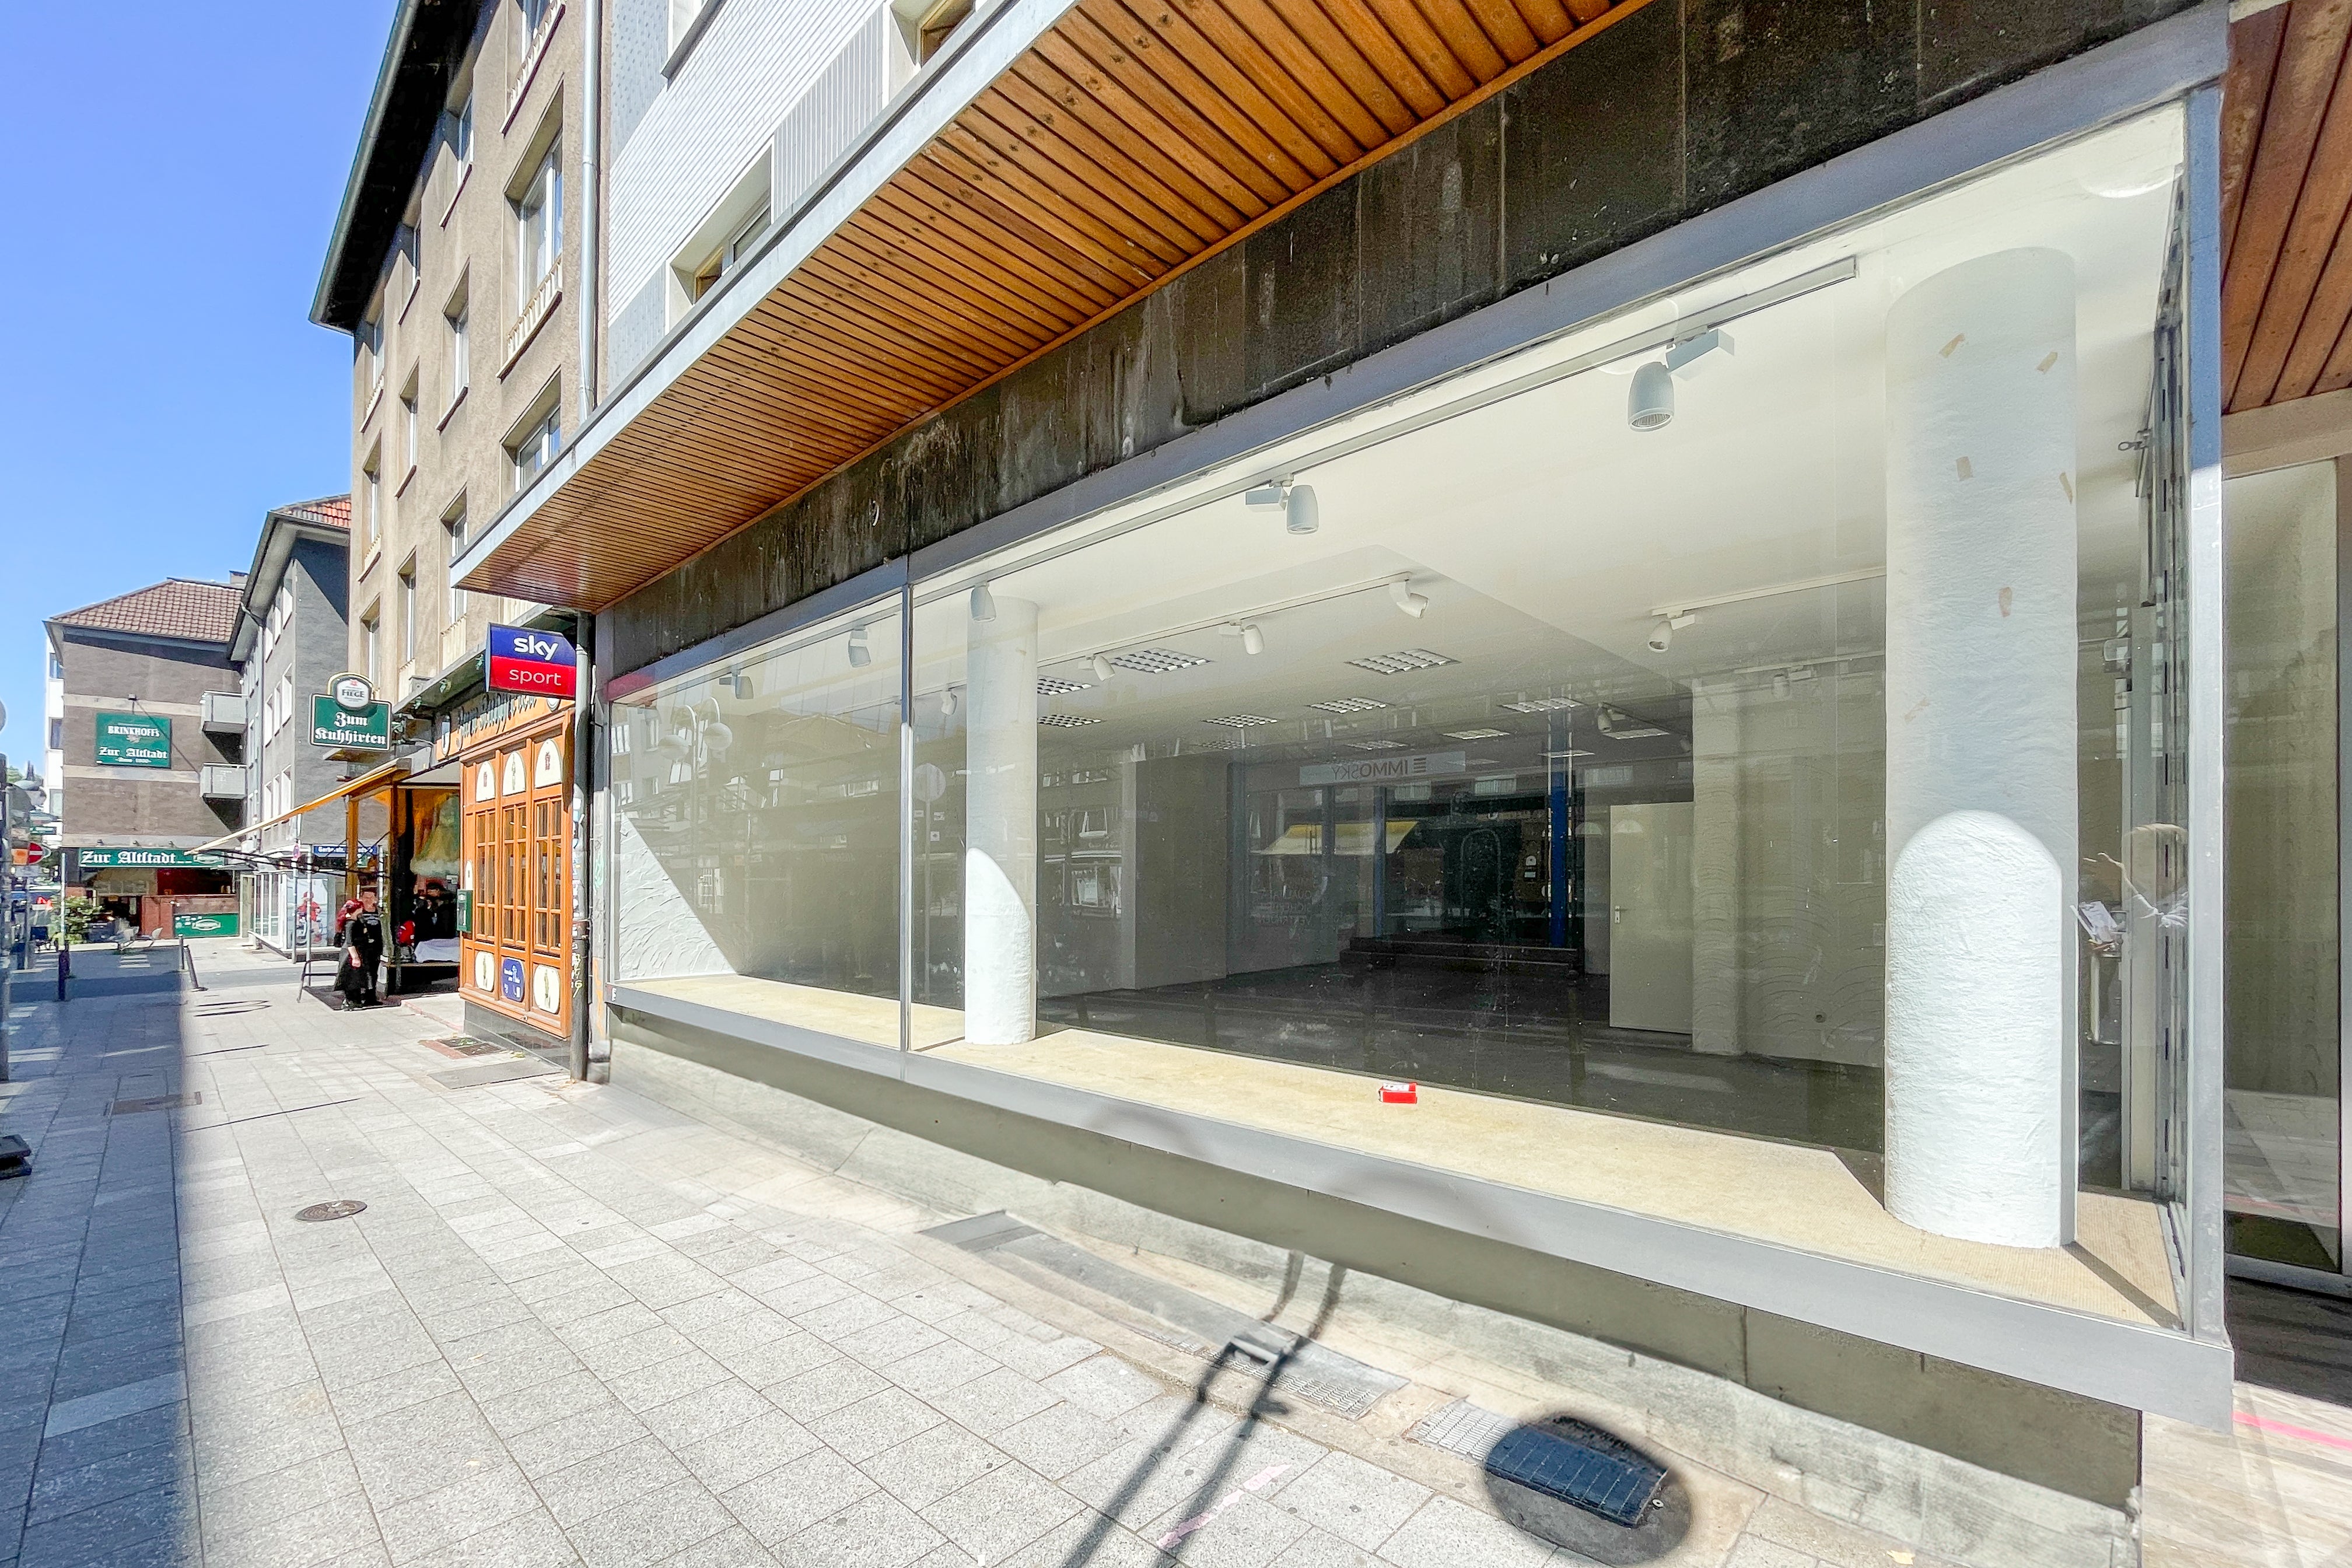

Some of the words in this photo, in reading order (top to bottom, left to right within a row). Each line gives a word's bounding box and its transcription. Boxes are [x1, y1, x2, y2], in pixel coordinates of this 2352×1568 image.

[513, 635, 558, 661] sky
[509, 669, 562, 687] sport
[334, 711, 369, 728] Zum
[314, 727, 386, 746] Kuhhirten
[98, 746, 120, 757] Zur
[80, 850, 112, 864] Zur
